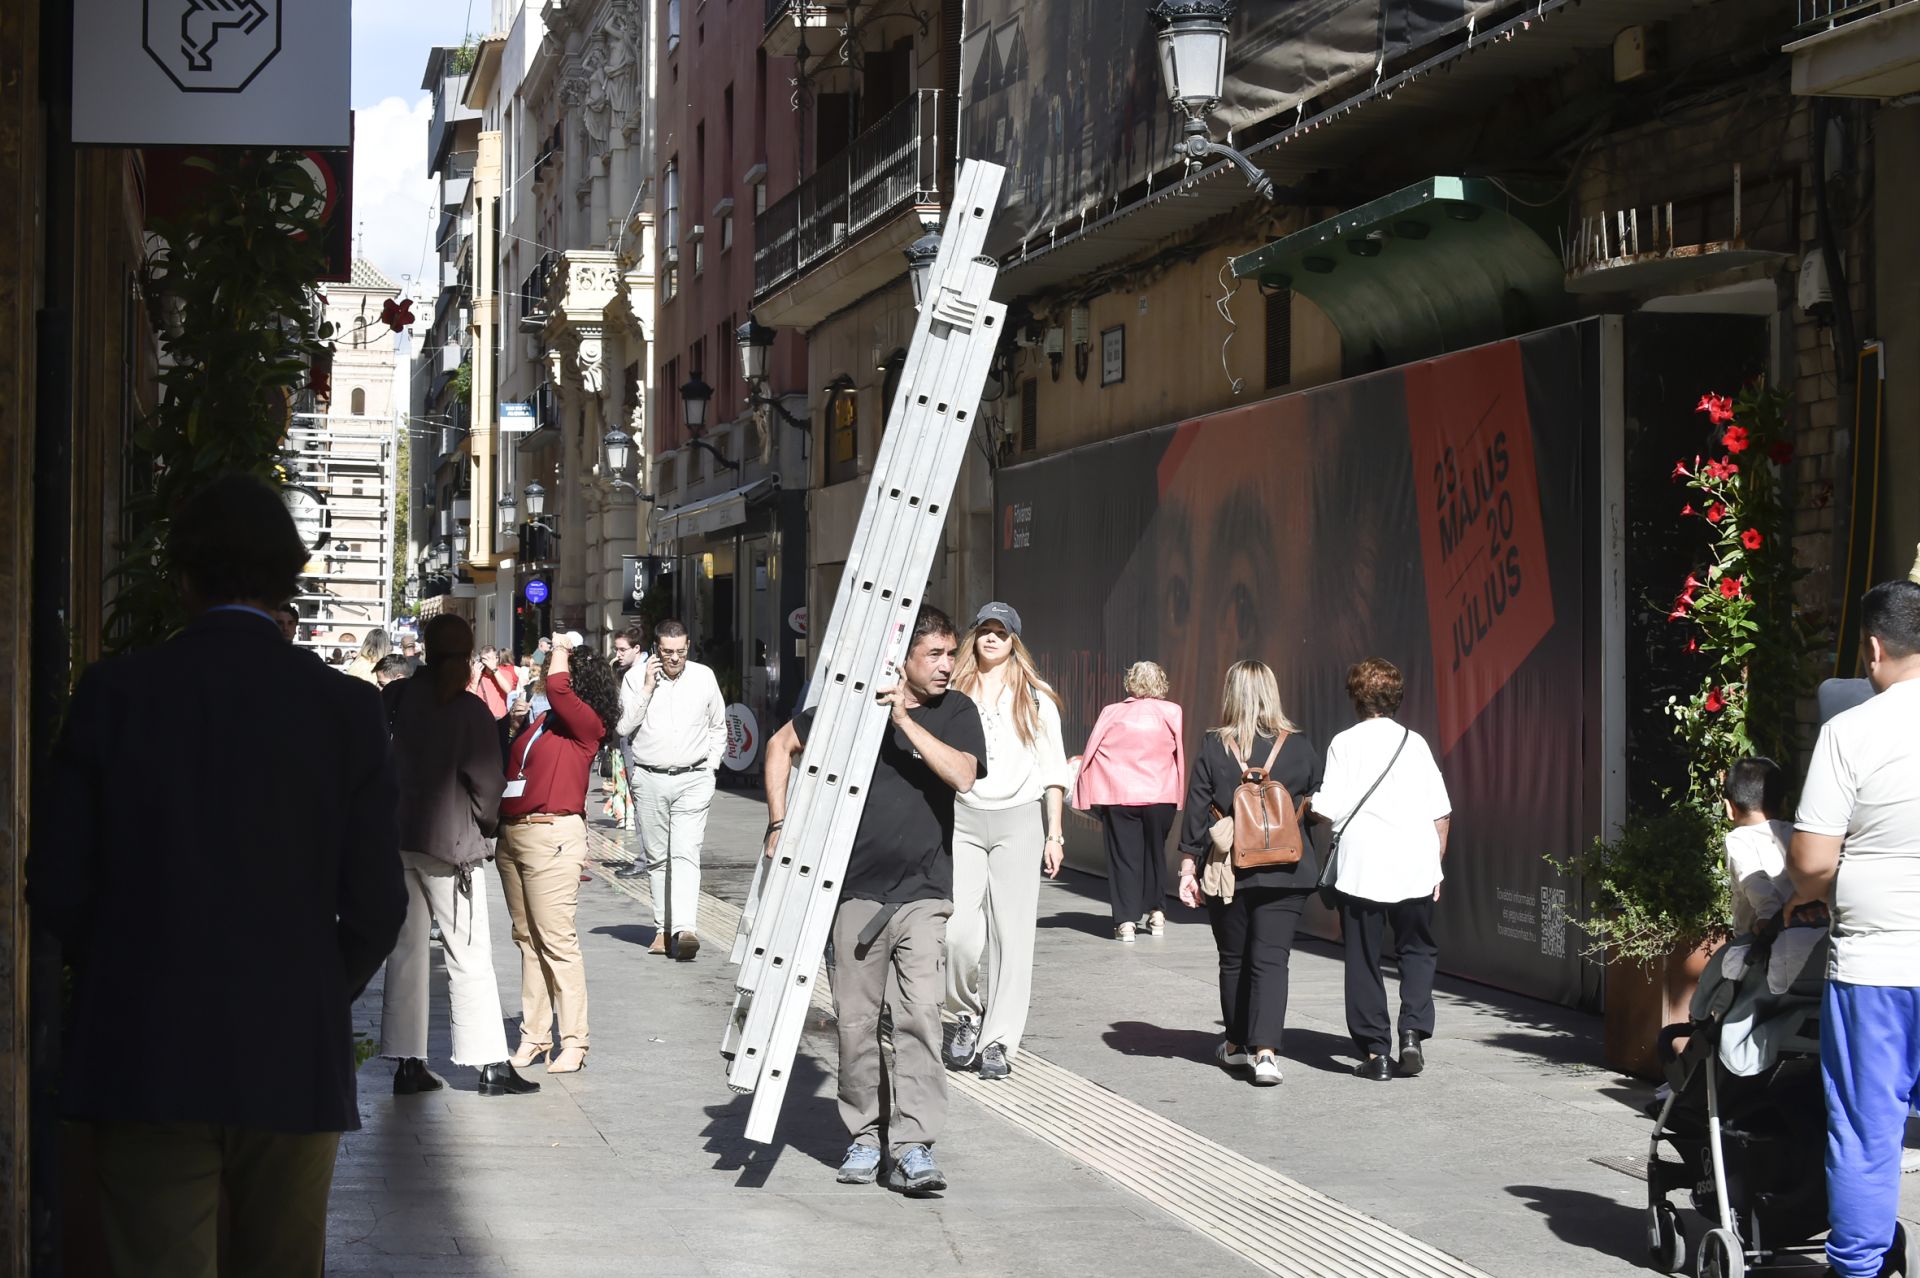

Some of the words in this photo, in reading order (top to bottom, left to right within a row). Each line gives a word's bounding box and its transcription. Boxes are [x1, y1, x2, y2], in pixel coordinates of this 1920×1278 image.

[1433, 446, 1456, 512] 23
[1438, 431, 1509, 563] MÁJUS
[1487, 489, 1514, 559] 20
[1453, 545, 1522, 673] JÚLIUS
[729, 714, 743, 744] Sanyi
